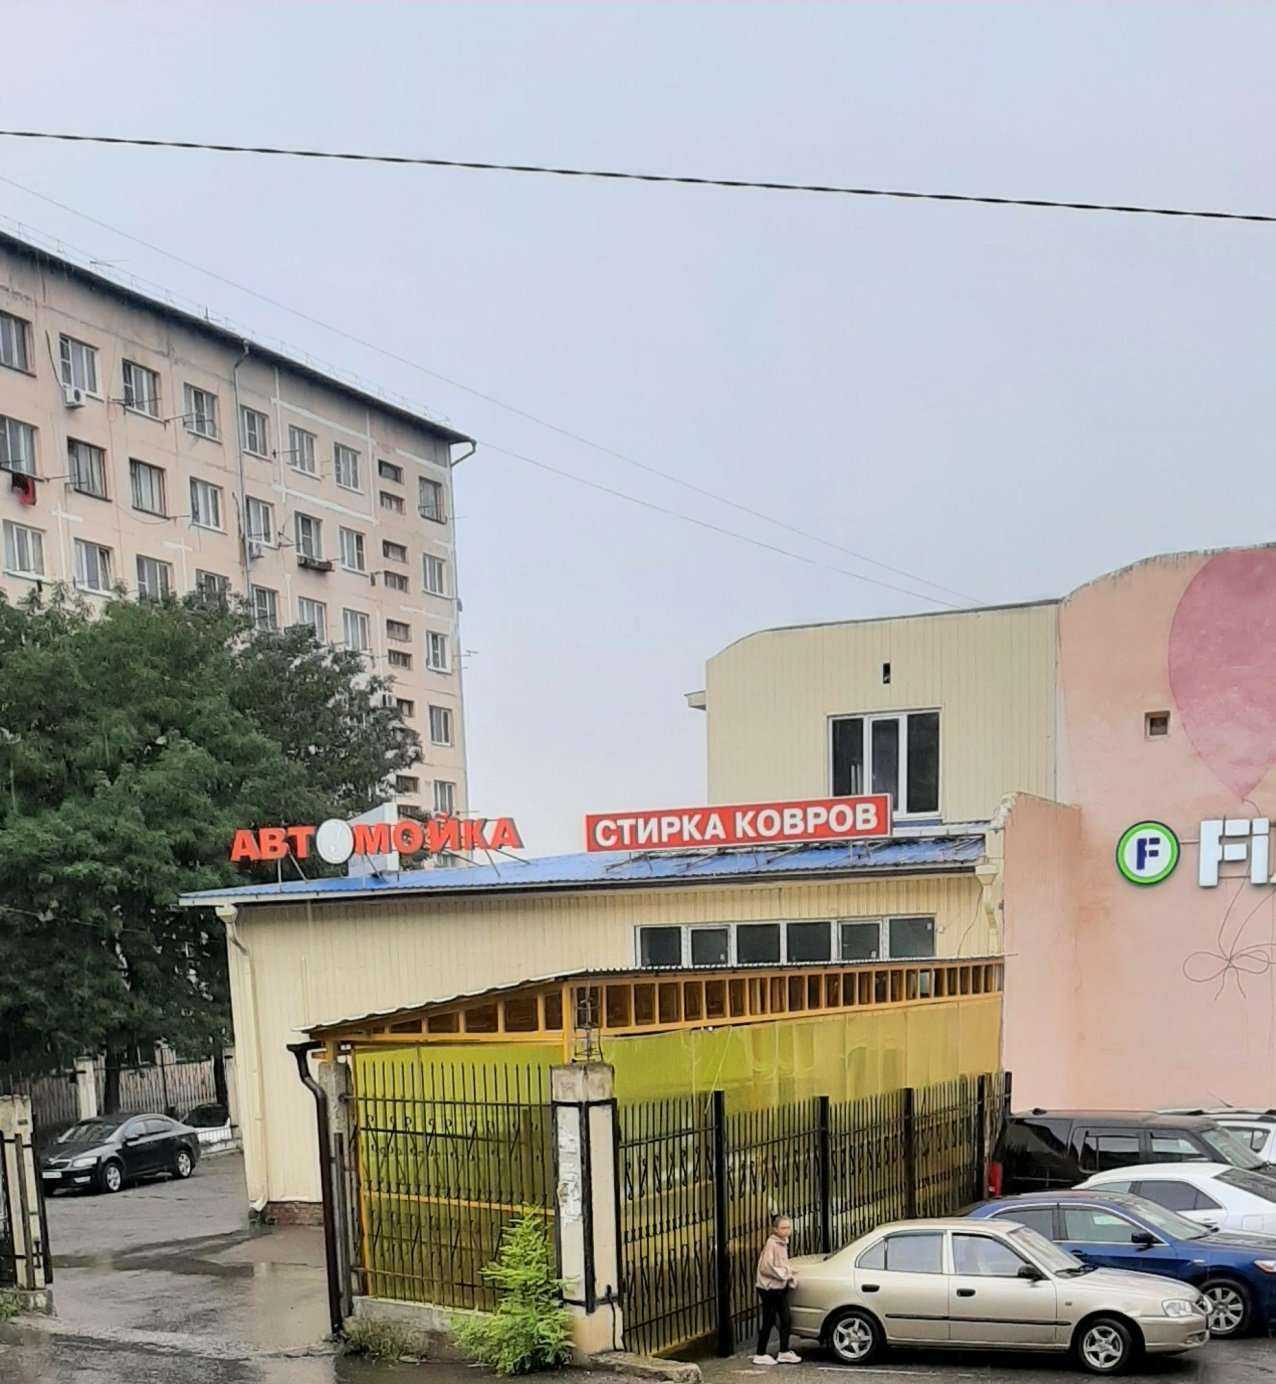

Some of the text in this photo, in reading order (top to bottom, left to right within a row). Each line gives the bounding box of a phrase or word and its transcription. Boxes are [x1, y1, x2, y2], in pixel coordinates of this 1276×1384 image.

[595, 802, 878, 848] СТИРКА КОВРОВ
[1199, 817, 1276, 887] Fi
